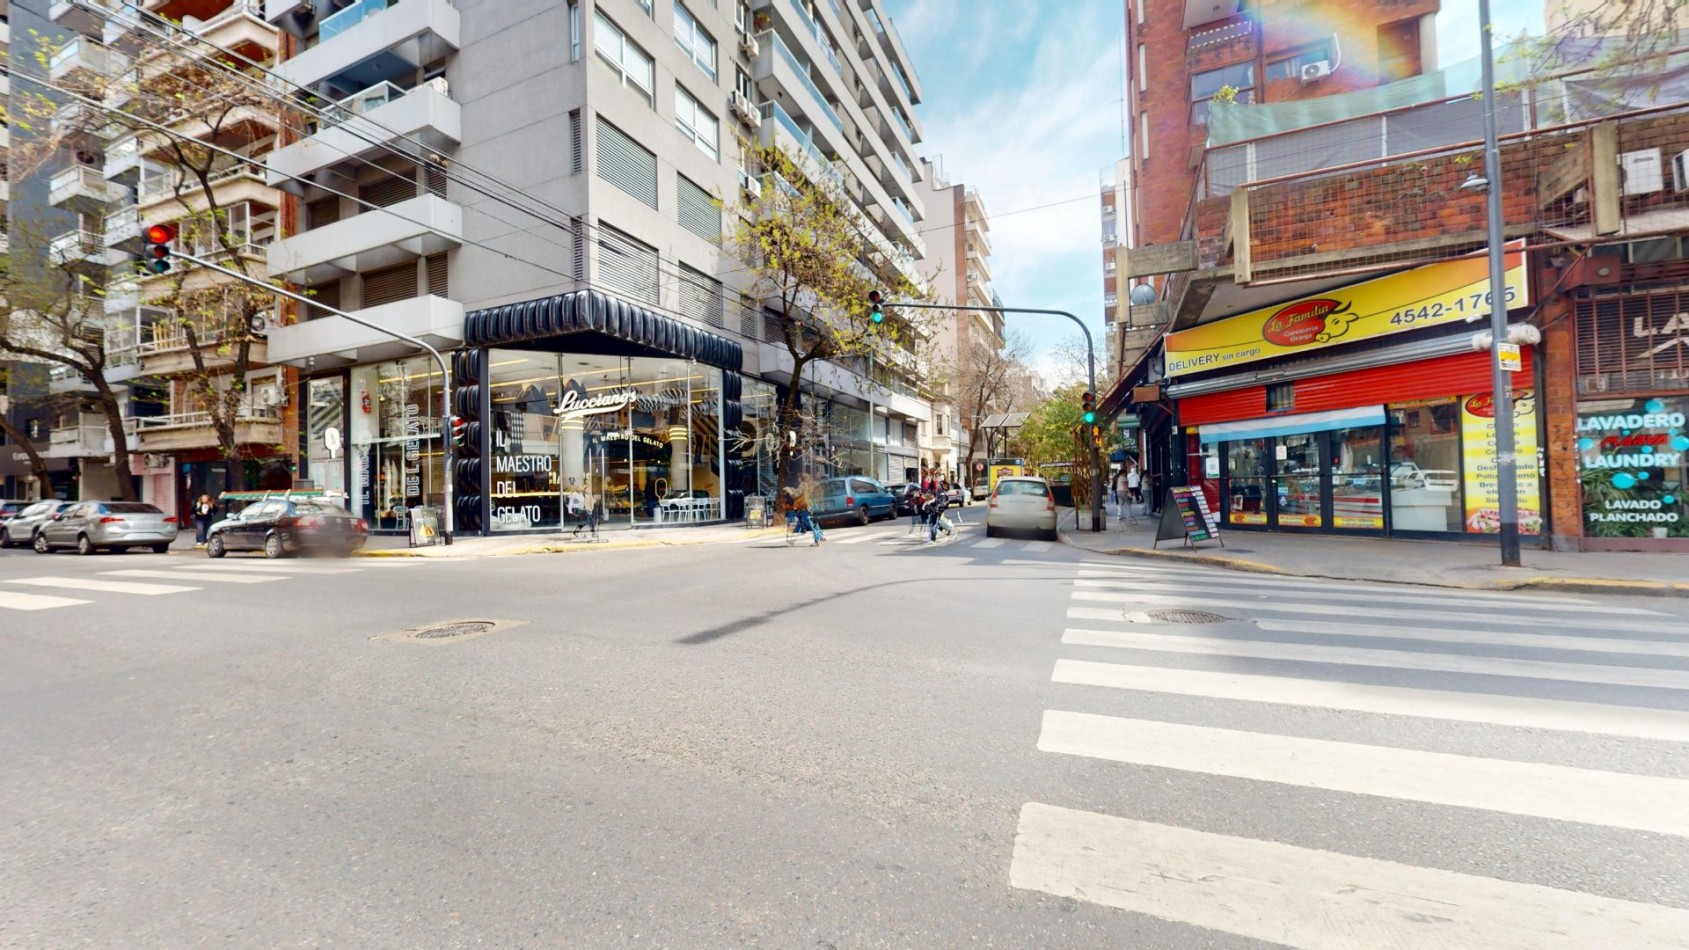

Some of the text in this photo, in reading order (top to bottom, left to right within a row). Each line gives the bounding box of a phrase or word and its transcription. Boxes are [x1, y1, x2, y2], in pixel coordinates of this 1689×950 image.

[1267, 304, 1329, 333] La Familia
[1168, 348, 1261, 372] DELIVERY sin cargo
[1577, 412, 1686, 431] LAVADERO
[497, 430, 506, 447] IL
[643, 436, 664, 449] GELATO
[406, 403, 420, 497] DEL GELATO
[496, 455, 551, 473] MAESTRO
[1584, 453, 1680, 468] LAUNDRY
[497, 481, 520, 498] DEL
[1605, 500, 1662, 510] LAVADO
[497, 505, 540, 523] GELATO
[1588, 512, 1679, 523] PLANCHADO
